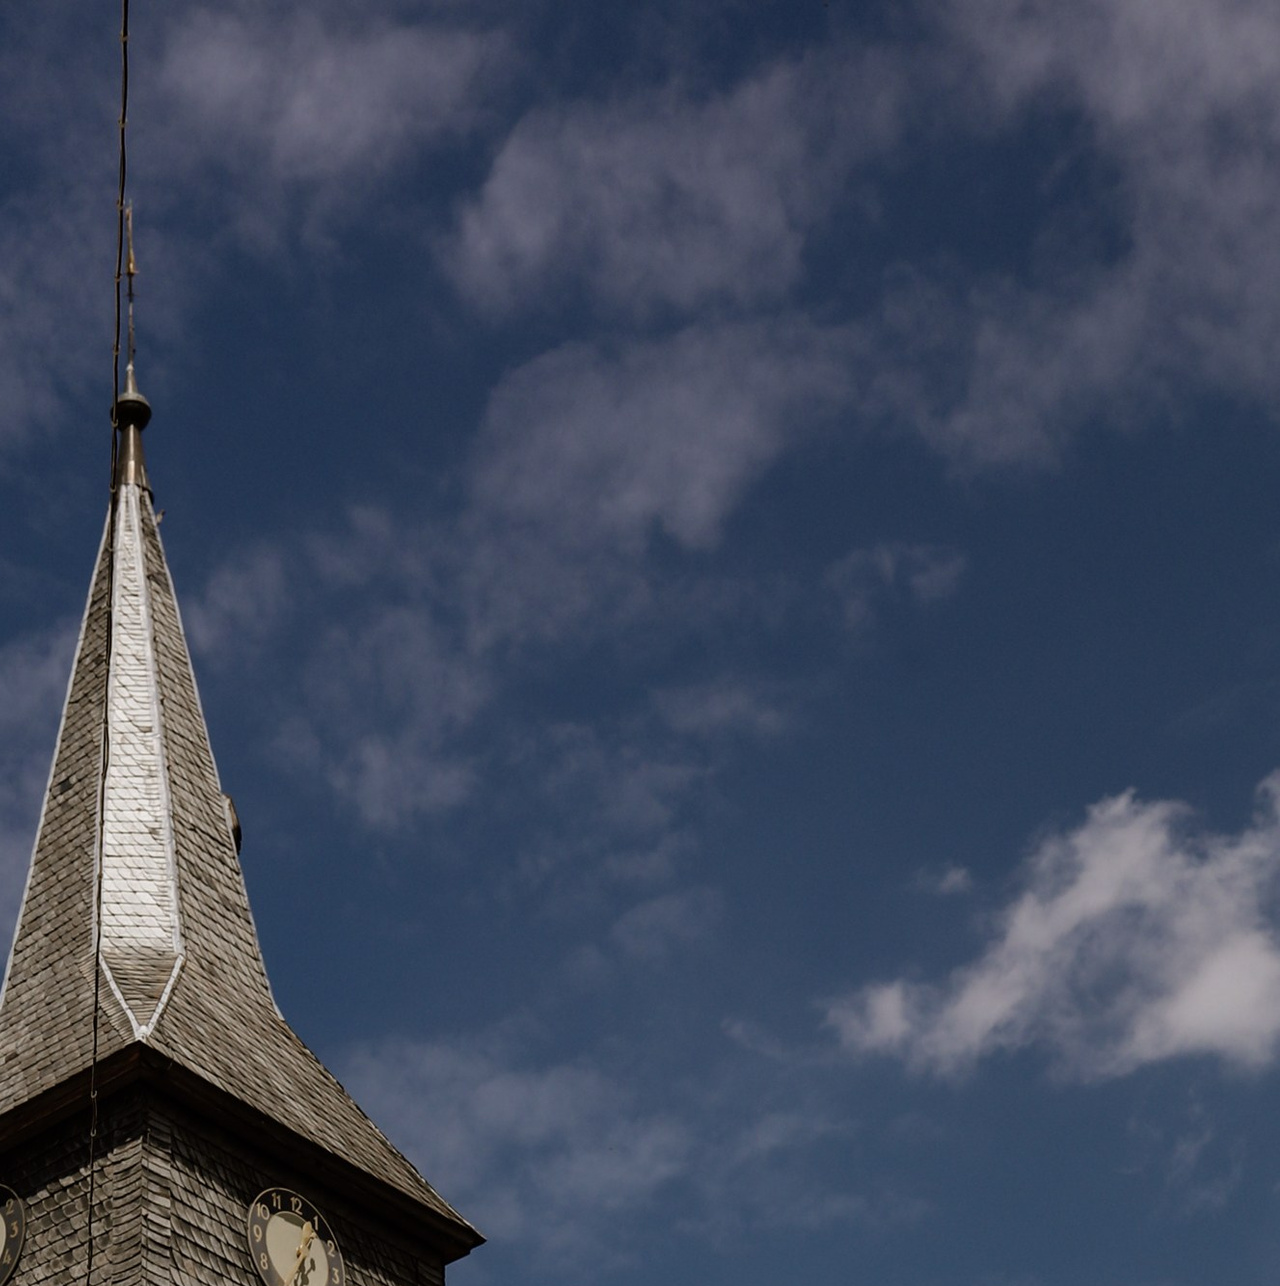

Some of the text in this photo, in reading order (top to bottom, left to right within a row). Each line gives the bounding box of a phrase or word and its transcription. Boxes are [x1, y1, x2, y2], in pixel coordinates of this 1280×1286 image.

[6, 1198, 14, 1215] 2
[272, 1192, 282, 1210] 11
[290, 1197, 303, 1215] 12
[256, 1202, 270, 1220] 10
[10, 1222, 18, 1238] 3
[313, 1216, 318, 1230] 1
[253, 1225, 262, 1242] 9
[326, 1240, 335, 1257] 2
[260, 1252, 268, 1270] 8
[332, 1268, 340, 1284] 3
